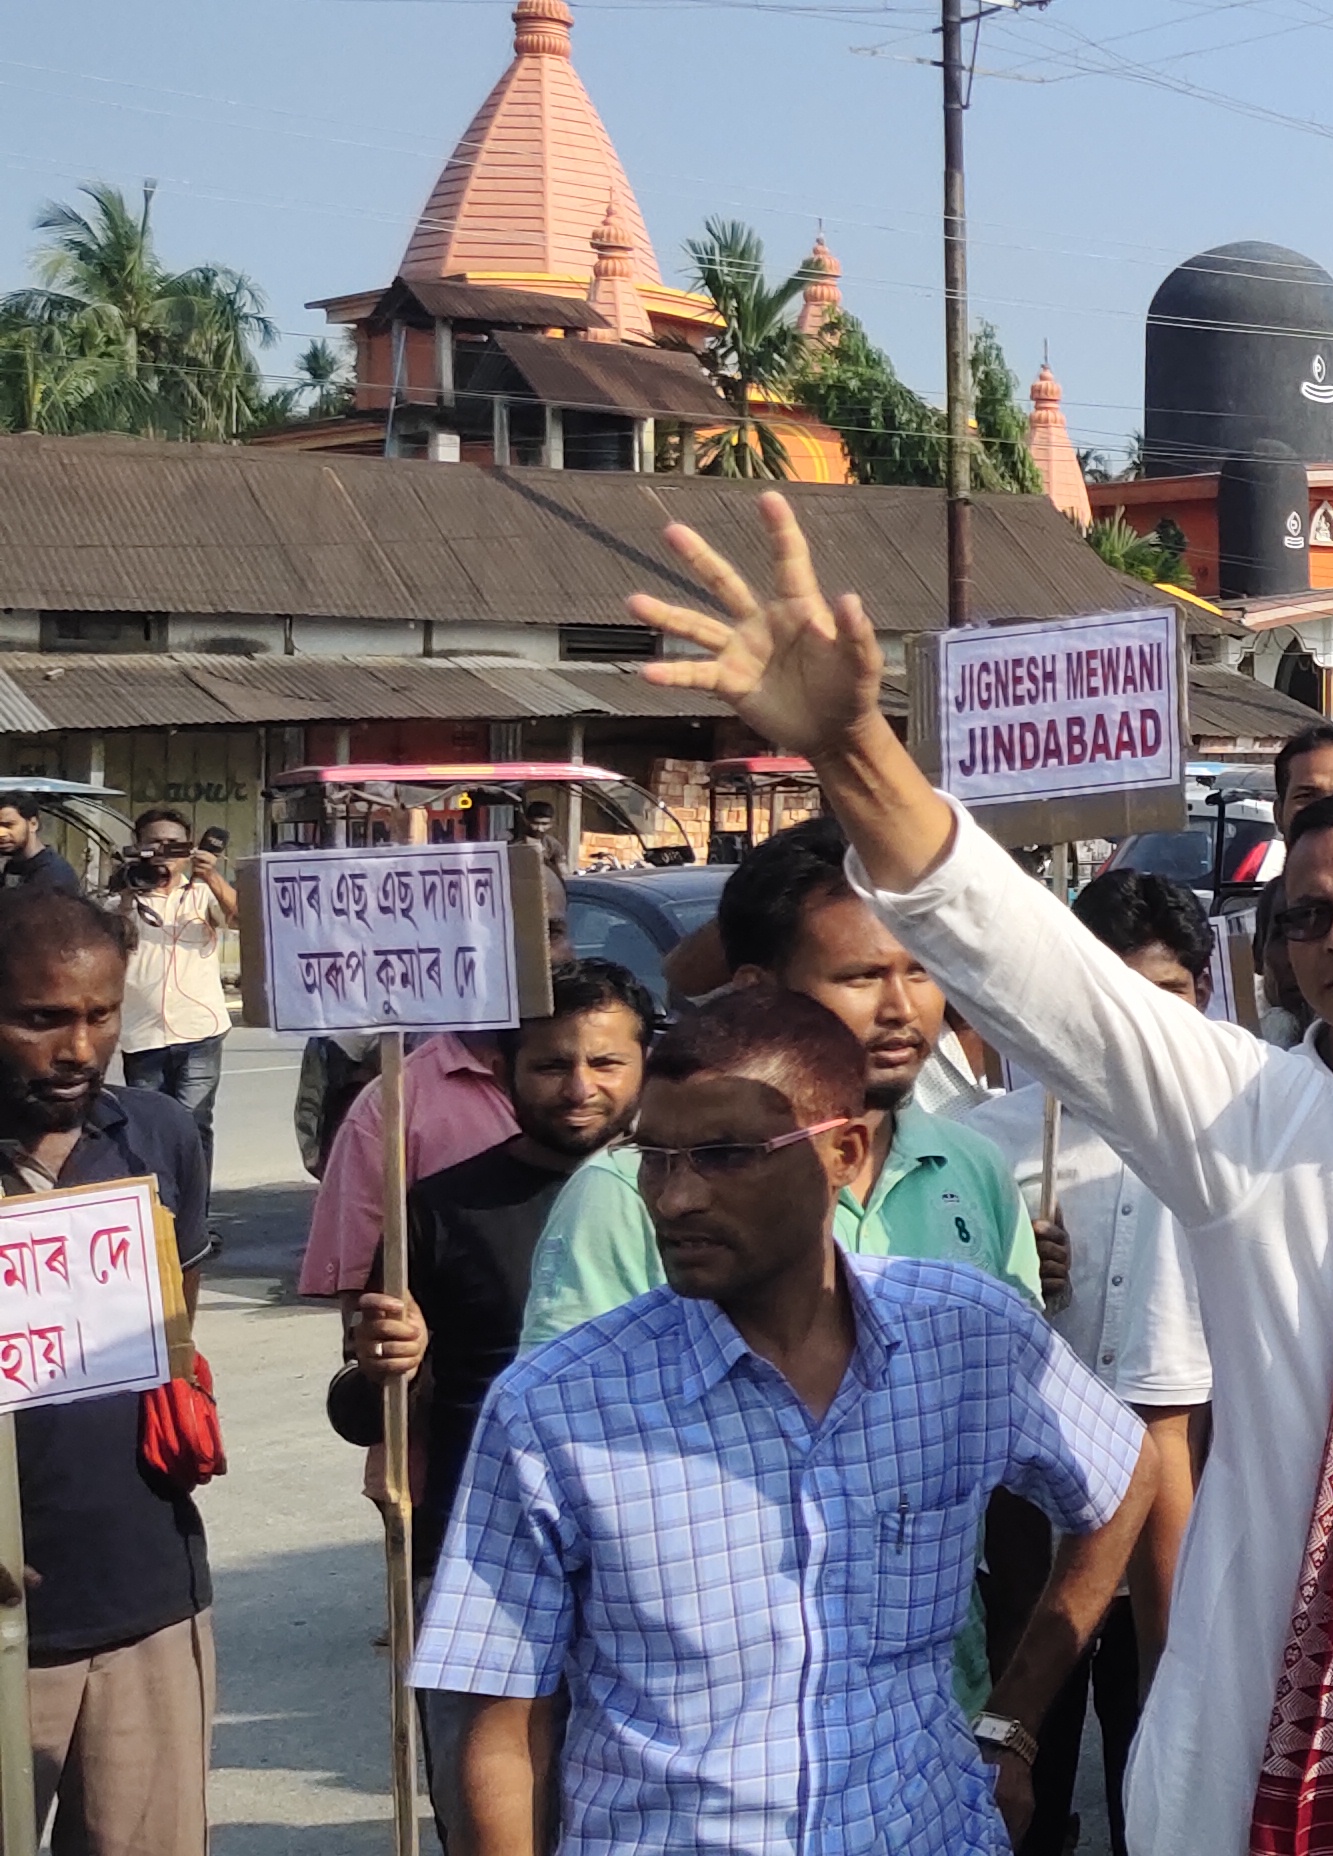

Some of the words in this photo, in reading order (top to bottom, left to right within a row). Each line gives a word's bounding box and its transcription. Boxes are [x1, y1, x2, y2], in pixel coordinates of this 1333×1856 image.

[955, 655, 1056, 713] JIGNESH
[1066, 643, 1162, 700] MEWANI
[959, 709, 1161, 776] JINDABAAD
[273, 871, 320, 926] আৰ
[331, 873, 372, 931] এছ
[377, 871, 417, 928] এছ
[418, 864, 495, 920] দালাল
[373, 946, 441, 1016] কুমাৰ
[454, 946, 475, 998] দে
[89, 1225, 132, 1285] দে
